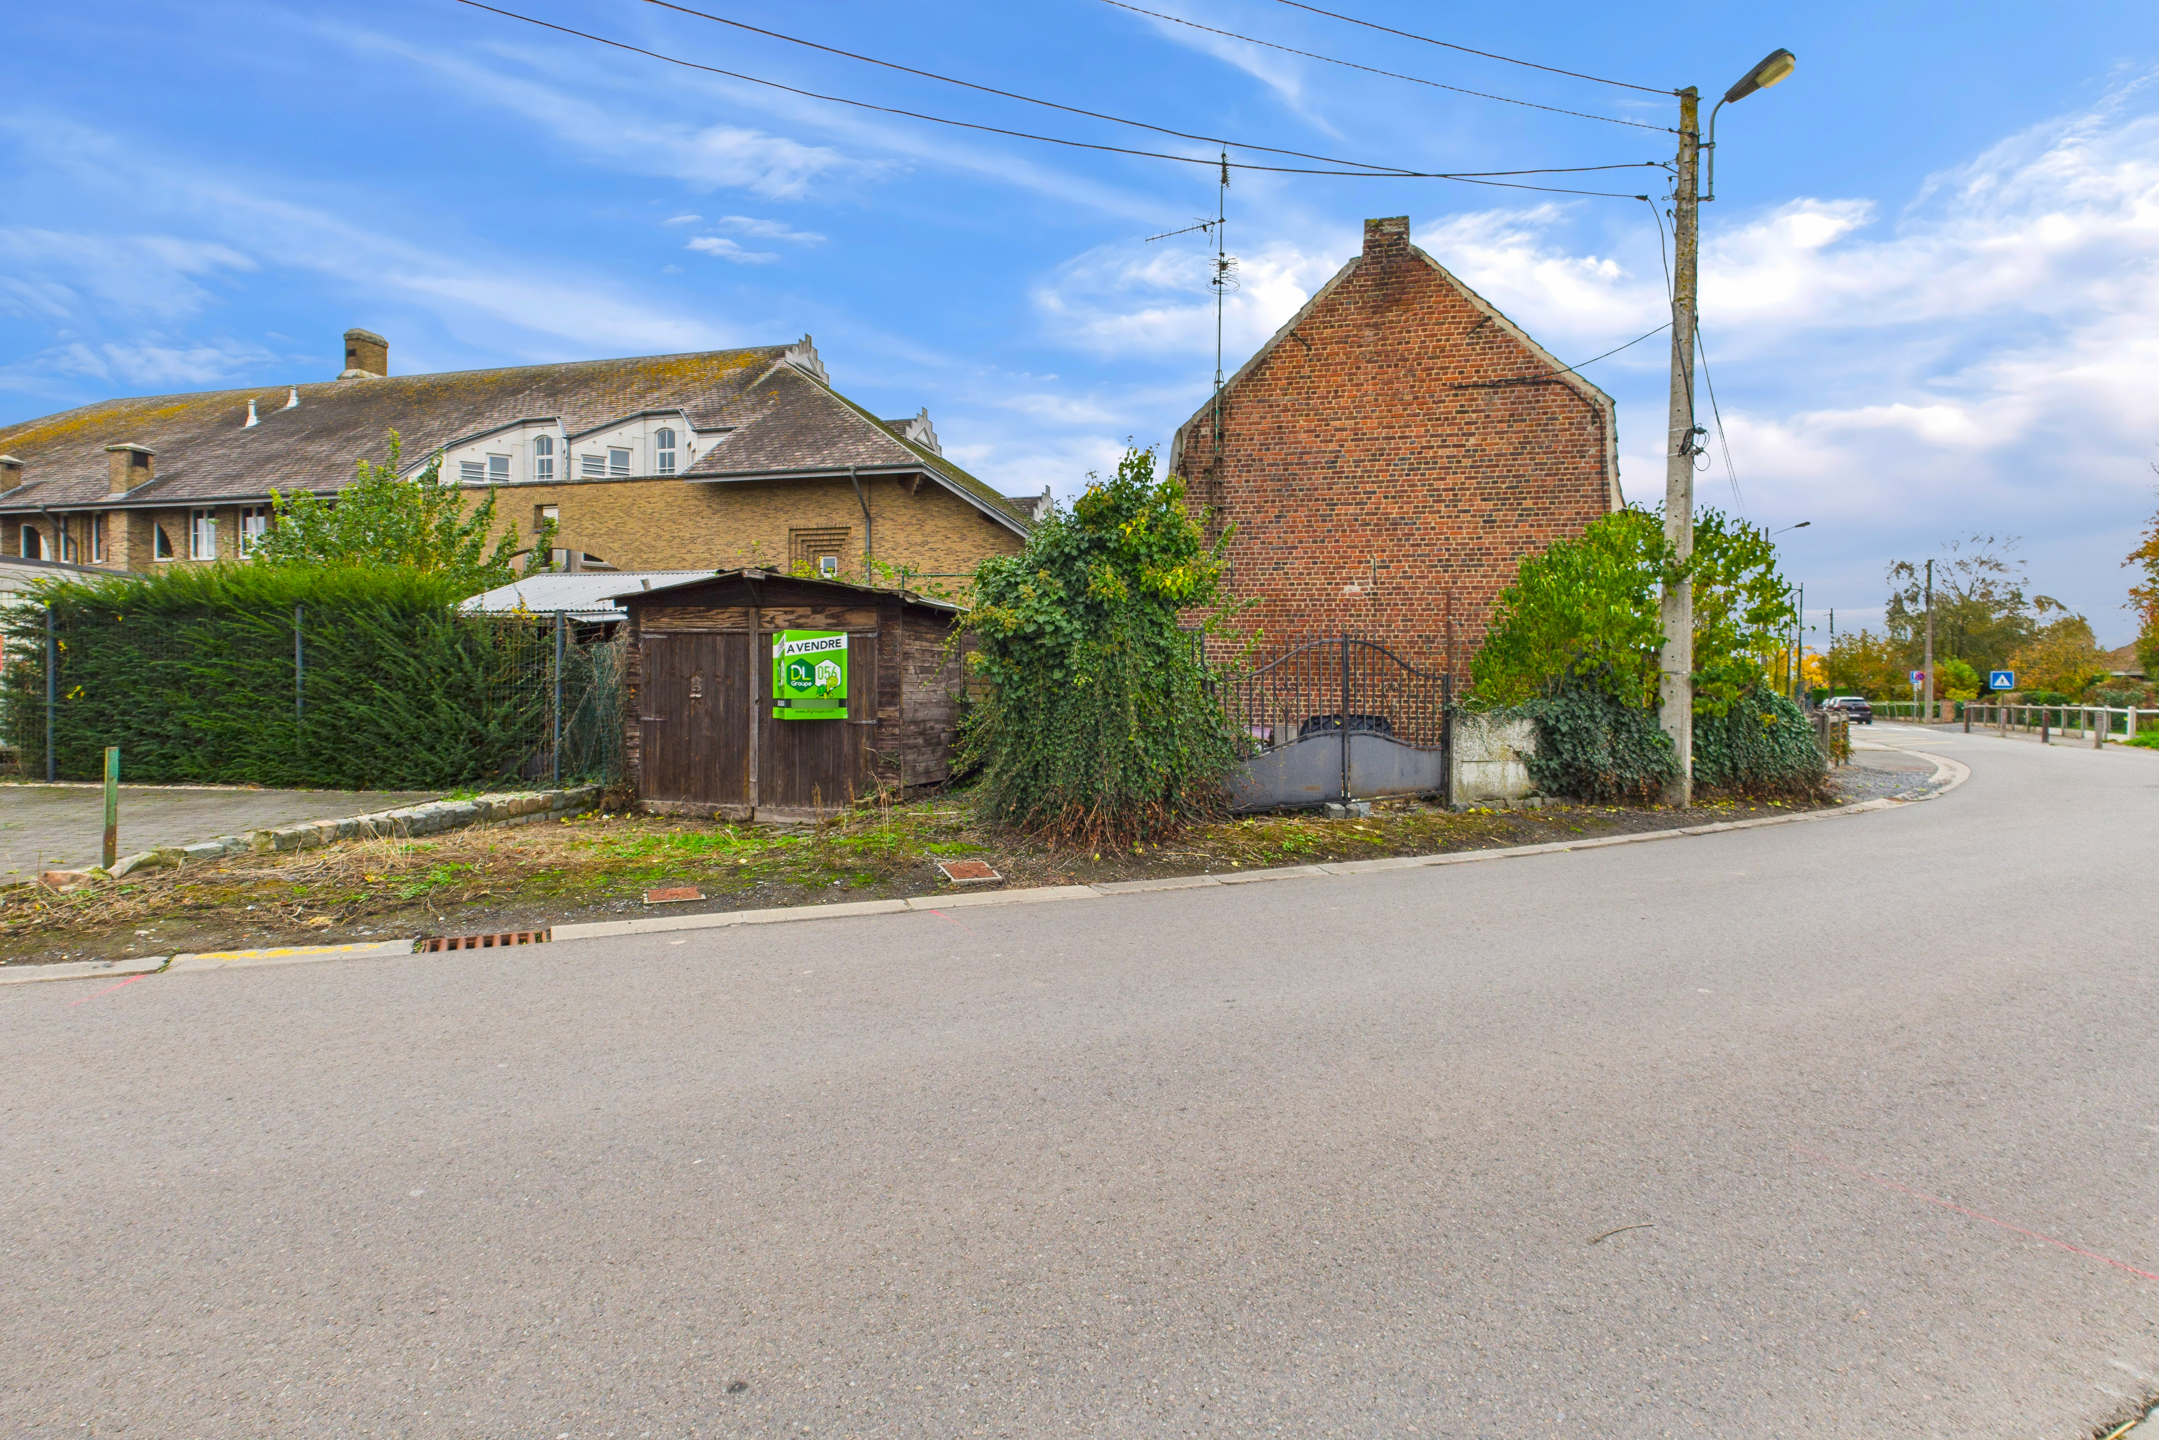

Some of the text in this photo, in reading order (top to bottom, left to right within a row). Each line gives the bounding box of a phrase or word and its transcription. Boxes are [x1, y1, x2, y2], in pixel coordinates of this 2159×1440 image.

[786, 644, 795, 654] A
[796, 638, 842, 652] VENDRE
[791, 664, 812, 680] DL
[817, 665, 838, 680] 056
